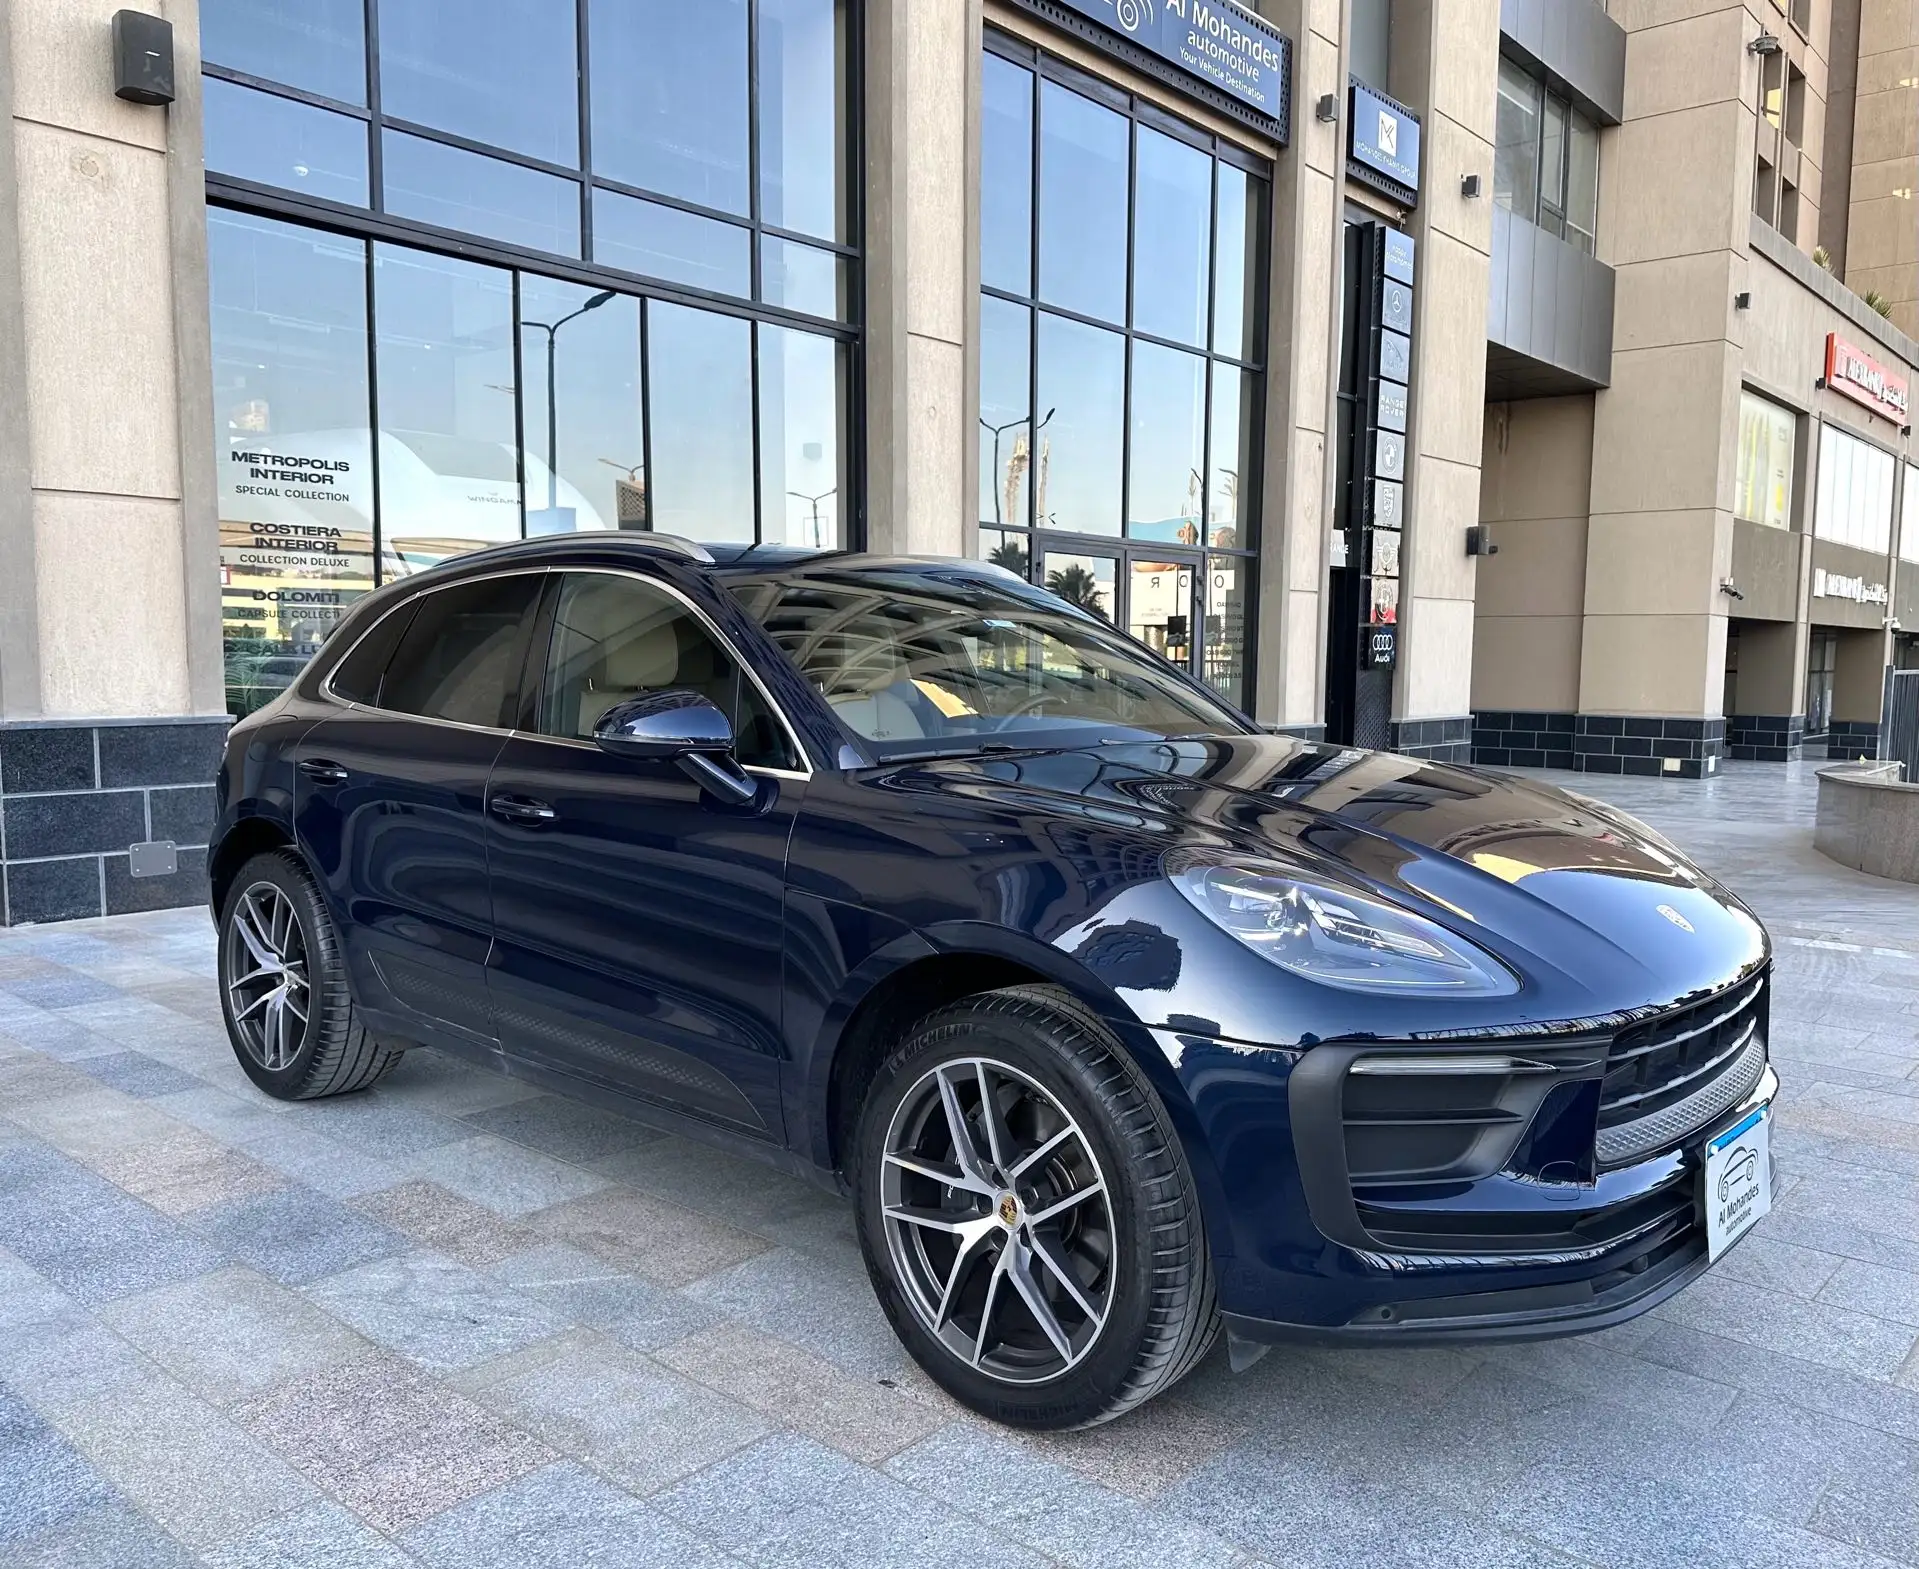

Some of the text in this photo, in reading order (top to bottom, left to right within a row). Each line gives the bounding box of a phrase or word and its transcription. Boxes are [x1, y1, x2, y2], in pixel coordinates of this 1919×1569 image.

[1166, 0, 1279, 72] Al Mohandes
[1188, 31, 1260, 82] automotive
[1180, 46, 1265, 103] Your Vehicle Destination
[231, 451, 350, 472] METROPOLIS
[250, 468, 334, 485] INTERIOR
[235, 485, 350, 502] SPECIAL COLLECTION
[250, 522, 342, 537] COSTIERA
[254, 537, 338, 552] INTERIOR
[239, 554, 350, 567] COLLECTION DELUXE
[237, 609, 288, 618] CAPSULE
[1375, 653, 1390, 663] Audi
[1719, 1182, 1760, 1228] Al Mohandes
